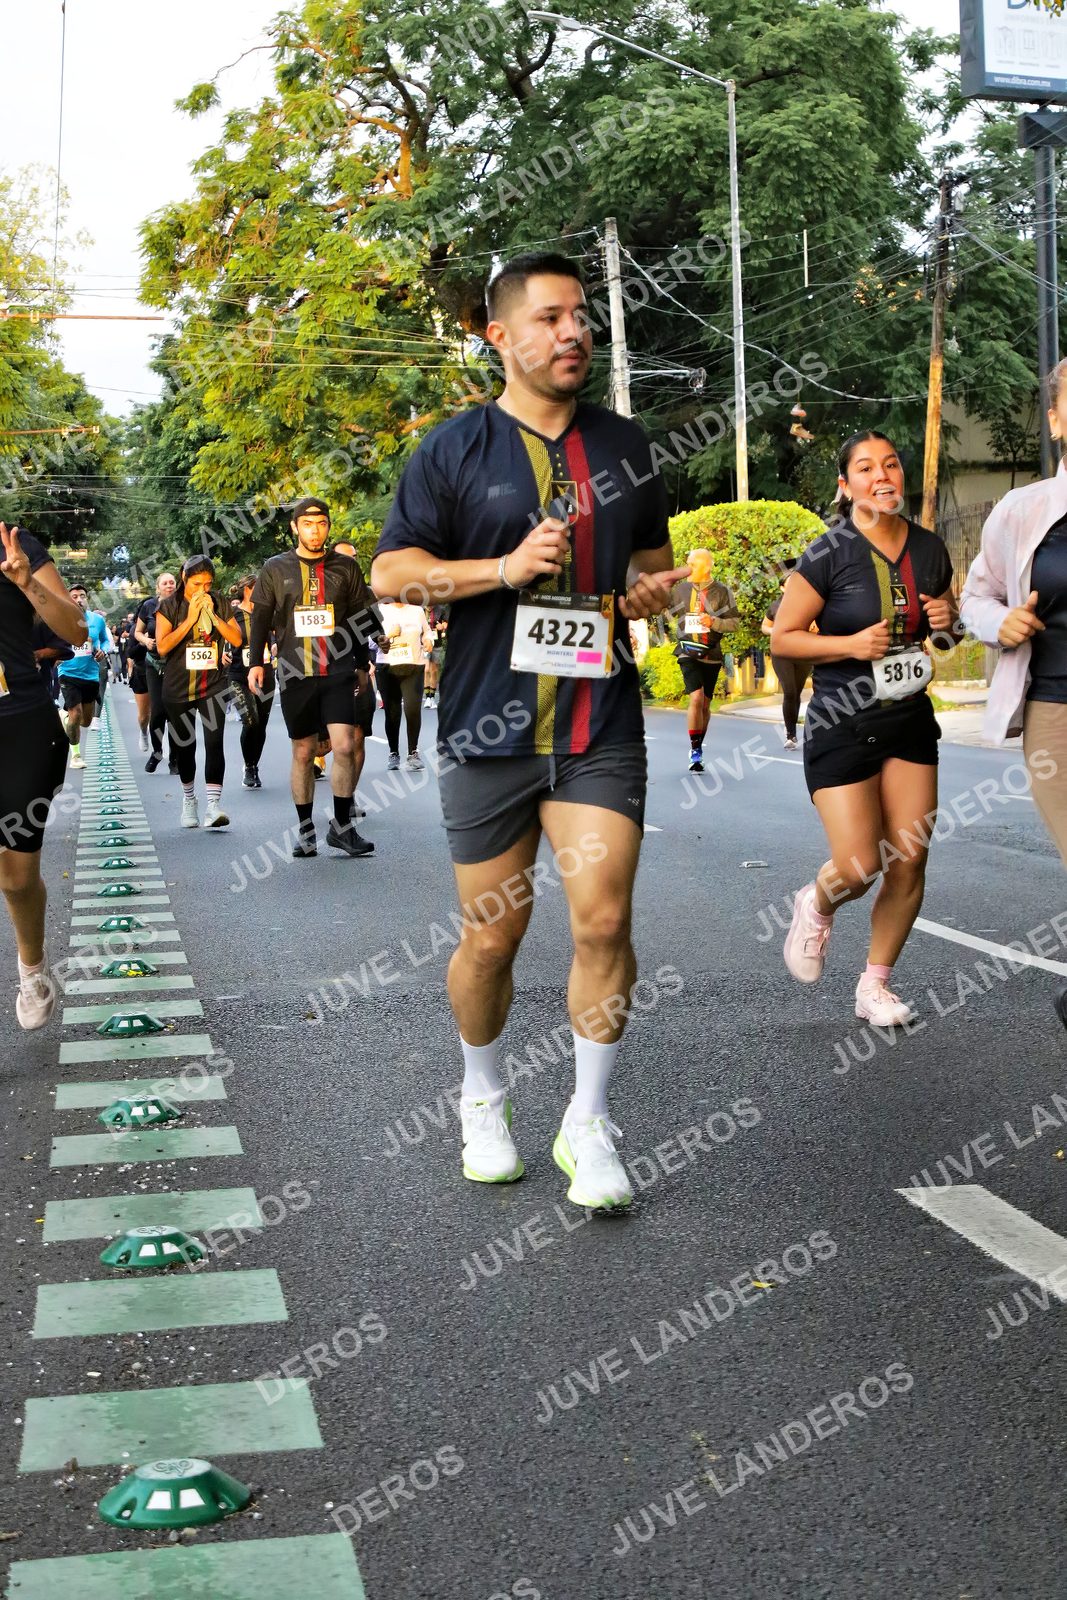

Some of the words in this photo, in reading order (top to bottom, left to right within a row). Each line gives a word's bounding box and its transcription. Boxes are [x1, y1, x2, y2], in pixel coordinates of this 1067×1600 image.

[300, 615, 326, 625] 1583
[527, 618, 596, 648] 4322
[191, 651, 213, 660] 5562
[883, 660, 924, 683] 5816
